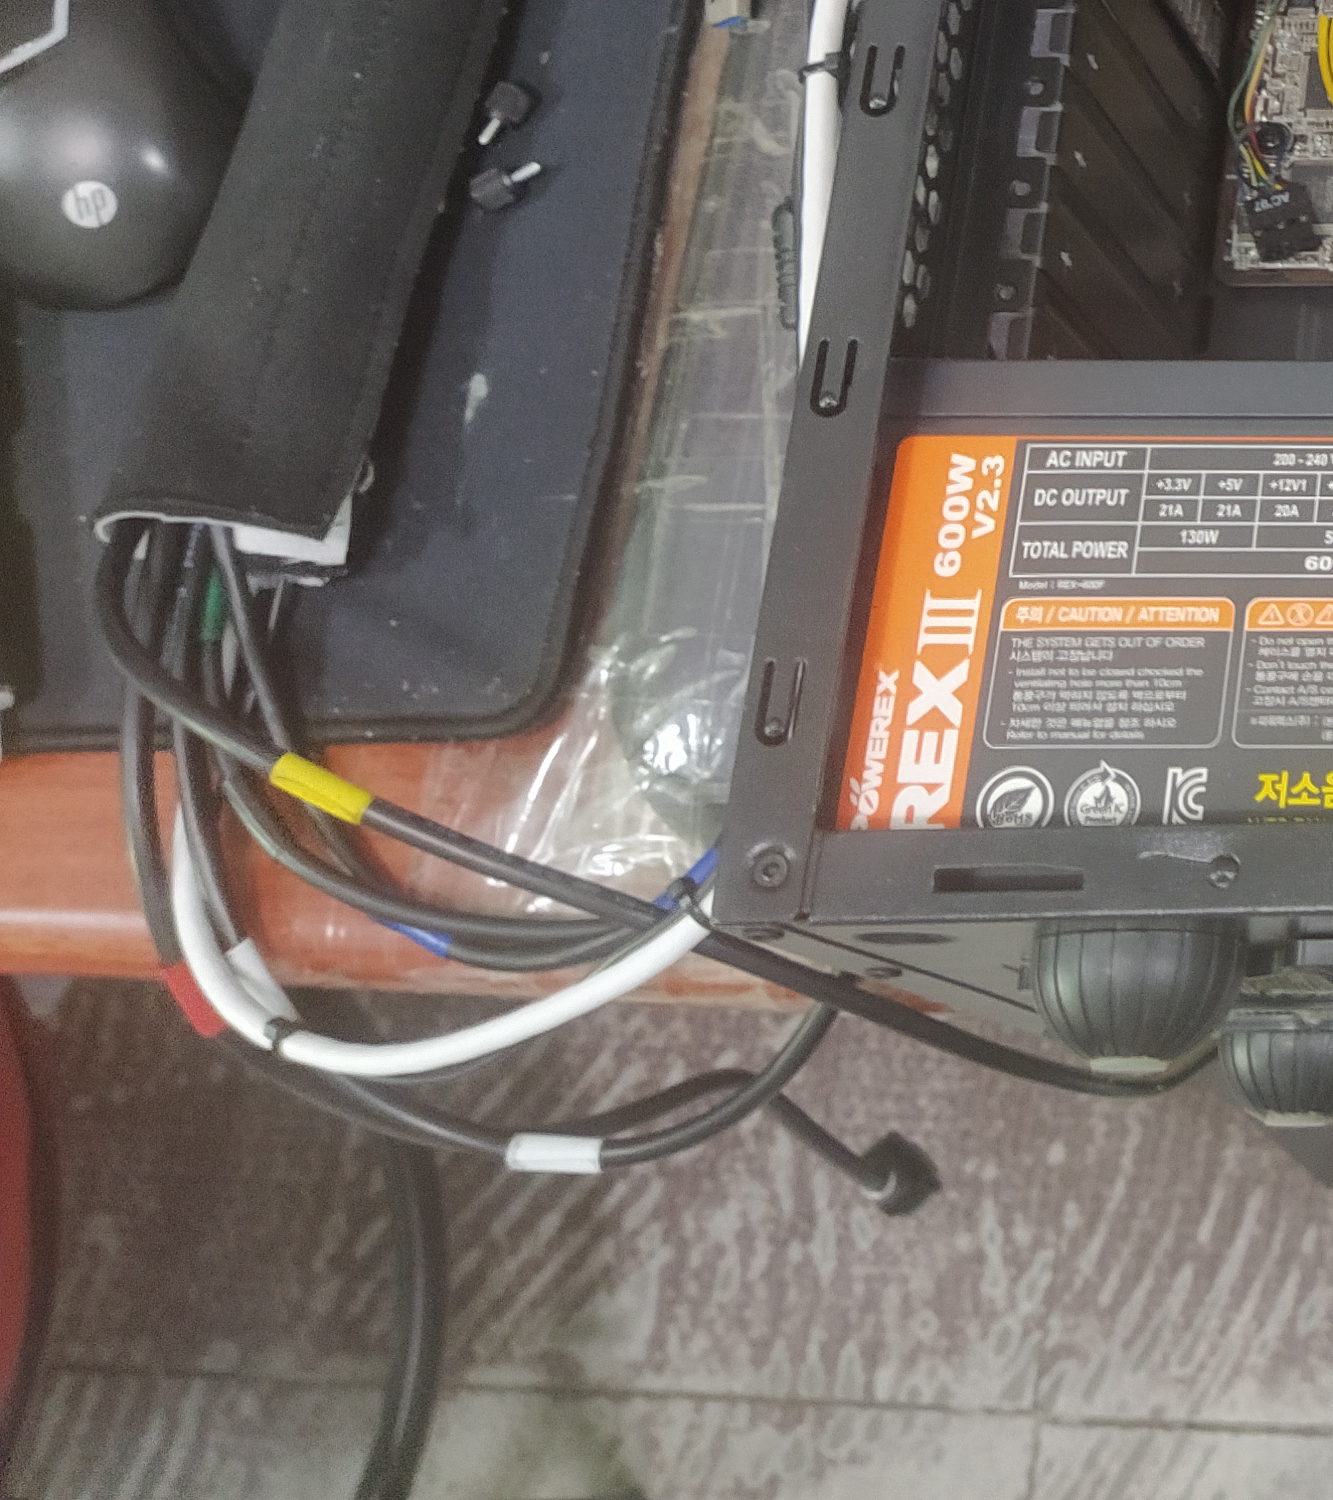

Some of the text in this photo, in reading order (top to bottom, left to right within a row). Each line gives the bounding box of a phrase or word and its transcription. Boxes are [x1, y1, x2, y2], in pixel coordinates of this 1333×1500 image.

[70, 182, 113, 229] hp
[1046, 450, 1128, 468] AC INPUT
[1156, 478, 1192, 492] +3.3V
[1218, 478, 1243, 492] +5V
[1269, 479, 1308, 493] +12V1
[971, 454, 1005, 540] V2.3
[1033, 488, 1130, 507] DC OUTPUT
[933, 453, 978, 578] 600W
[1158, 504, 1184, 518] 21A
[1216, 504, 1242, 518] 21A
[1273, 504, 1300, 518] 20A
[1179, 529, 1220, 545] 130W
[1022, 541, 1129, 559] TOTAL POWER
[1016, 606, 1043, 624] 주의
[1058, 606, 1123, 623] CAUTION
[1137, 606, 1220, 623] ATTENTION
[1011, 637, 1205, 648] THE SYSTEM GETS OUT OF ORDER
[890, 588, 982, 831] REX III
